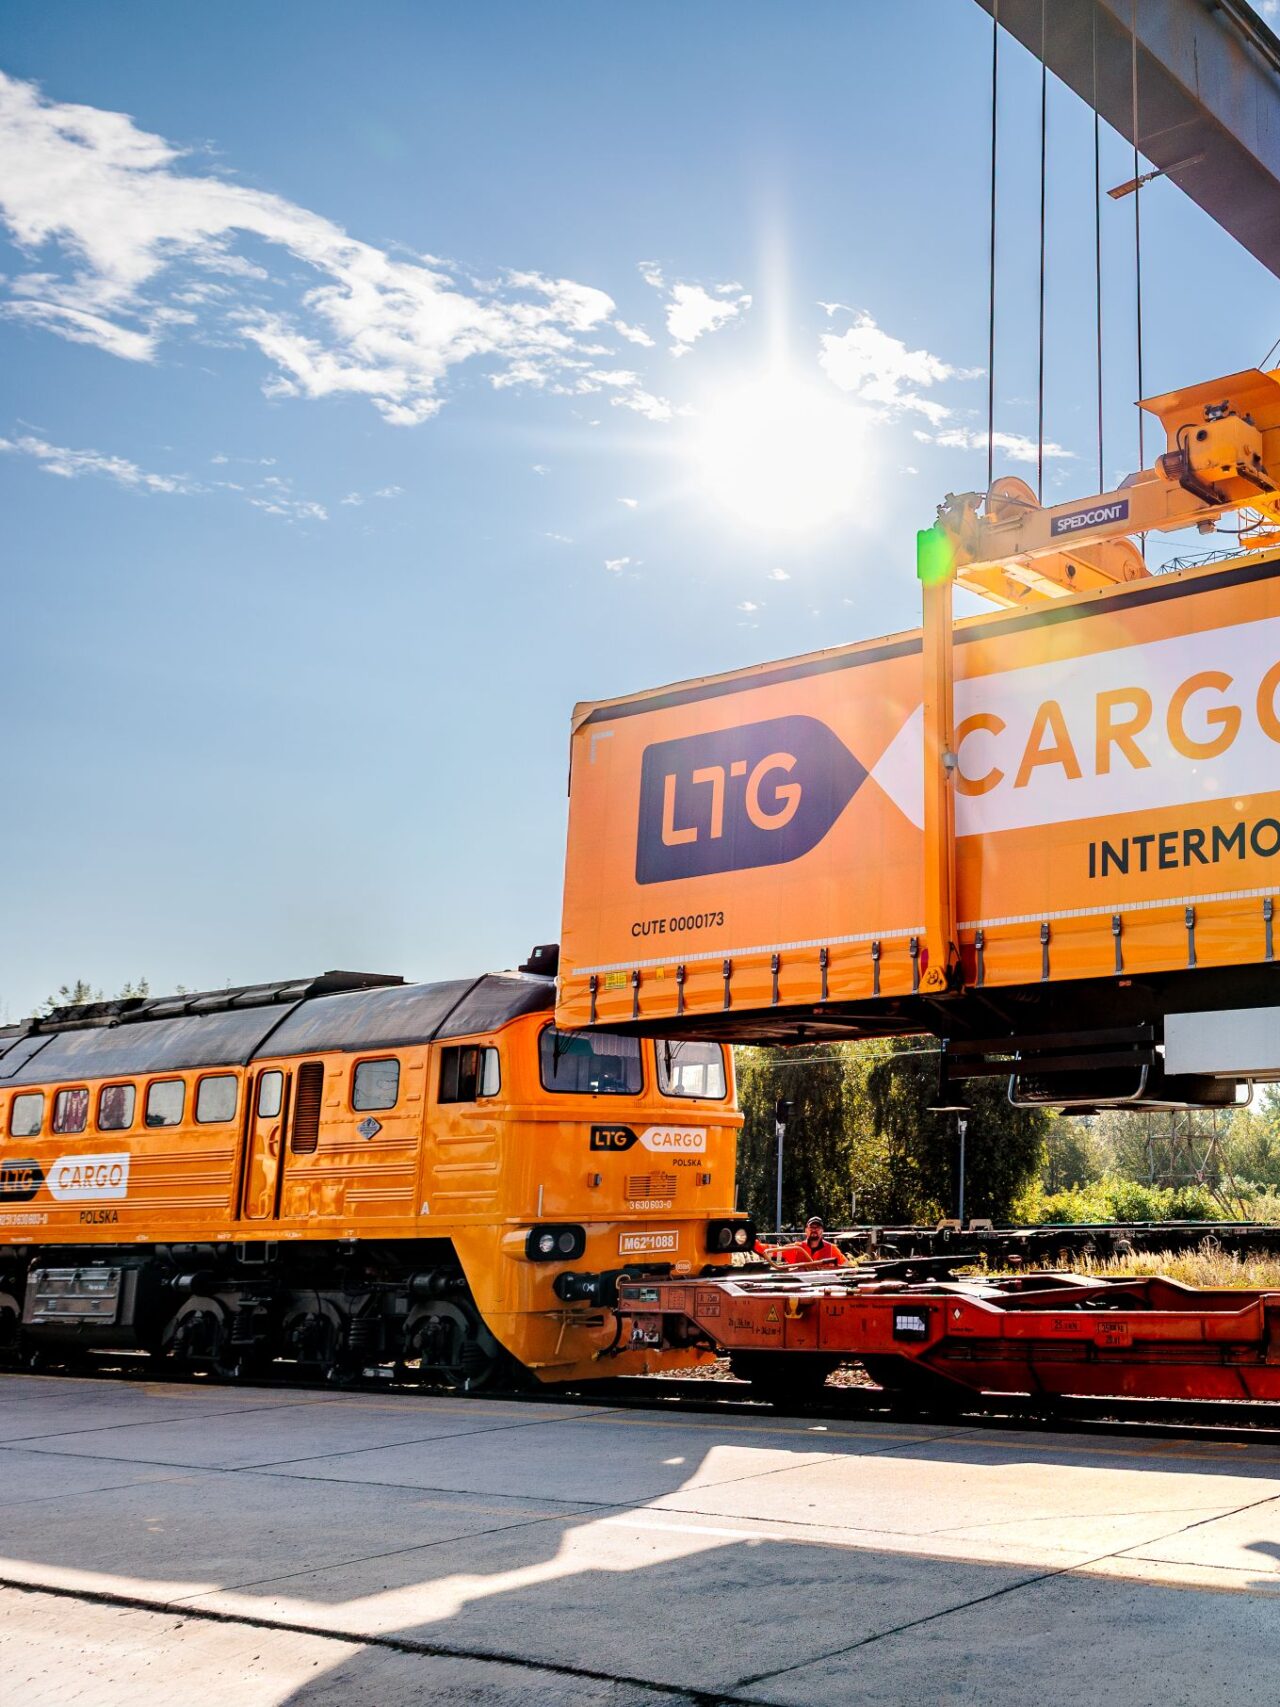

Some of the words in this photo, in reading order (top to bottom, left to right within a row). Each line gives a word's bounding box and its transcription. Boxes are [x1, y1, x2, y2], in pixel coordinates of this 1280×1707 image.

[1057, 504, 1123, 532] SPEDCONT
[661, 751, 804, 848] LTG
[631, 919, 667, 937] CUTE
[669, 911, 724, 932] 0000173
[595, 1131, 628, 1146] LTG
[651, 1132, 703, 1147] CARGO
[672, 1158, 702, 1167] POLSKA
[58, 1164, 123, 1190] CARGO
[79, 1209, 119, 1225] POLSKA
